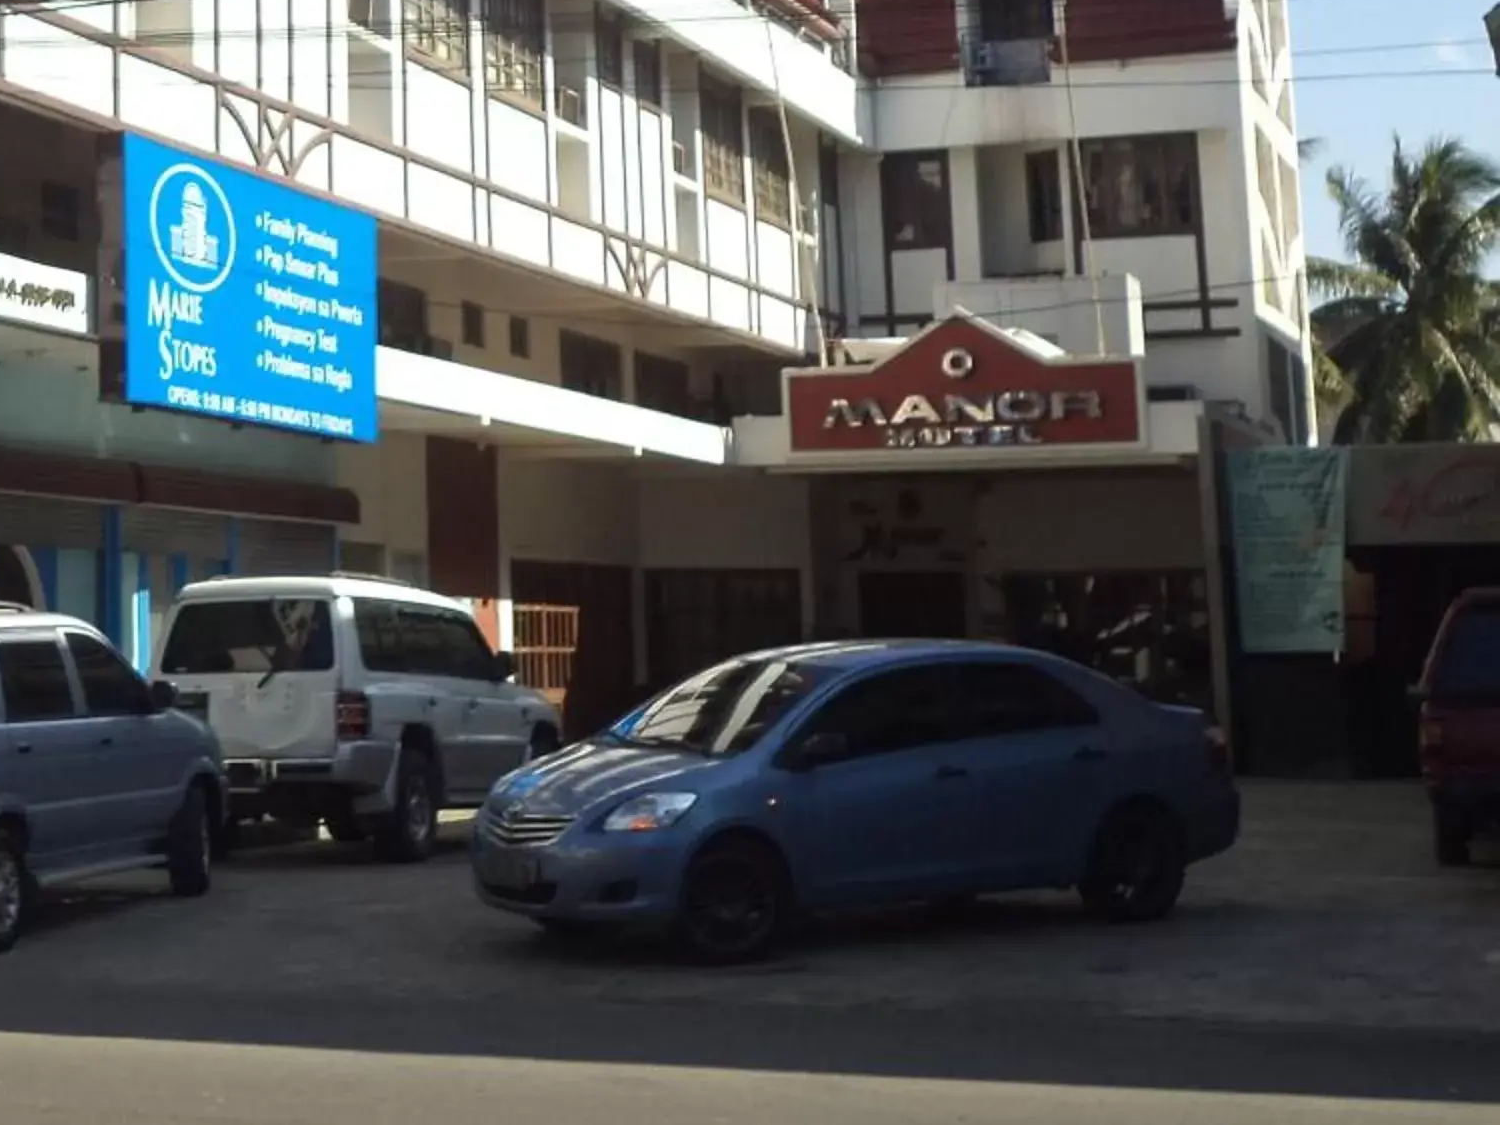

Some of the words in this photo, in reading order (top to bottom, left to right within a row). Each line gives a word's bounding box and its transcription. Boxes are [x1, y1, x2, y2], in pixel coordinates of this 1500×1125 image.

[263, 209, 295, 246] Family
[296, 222, 339, 260] Planning
[148, 277, 204, 331] MARIE
[159, 330, 218, 381] STOPES
[263, 315, 316, 354] Pregnancy
[316, 328, 338, 354] Test
[822, 388, 1104, 430] MANOR
